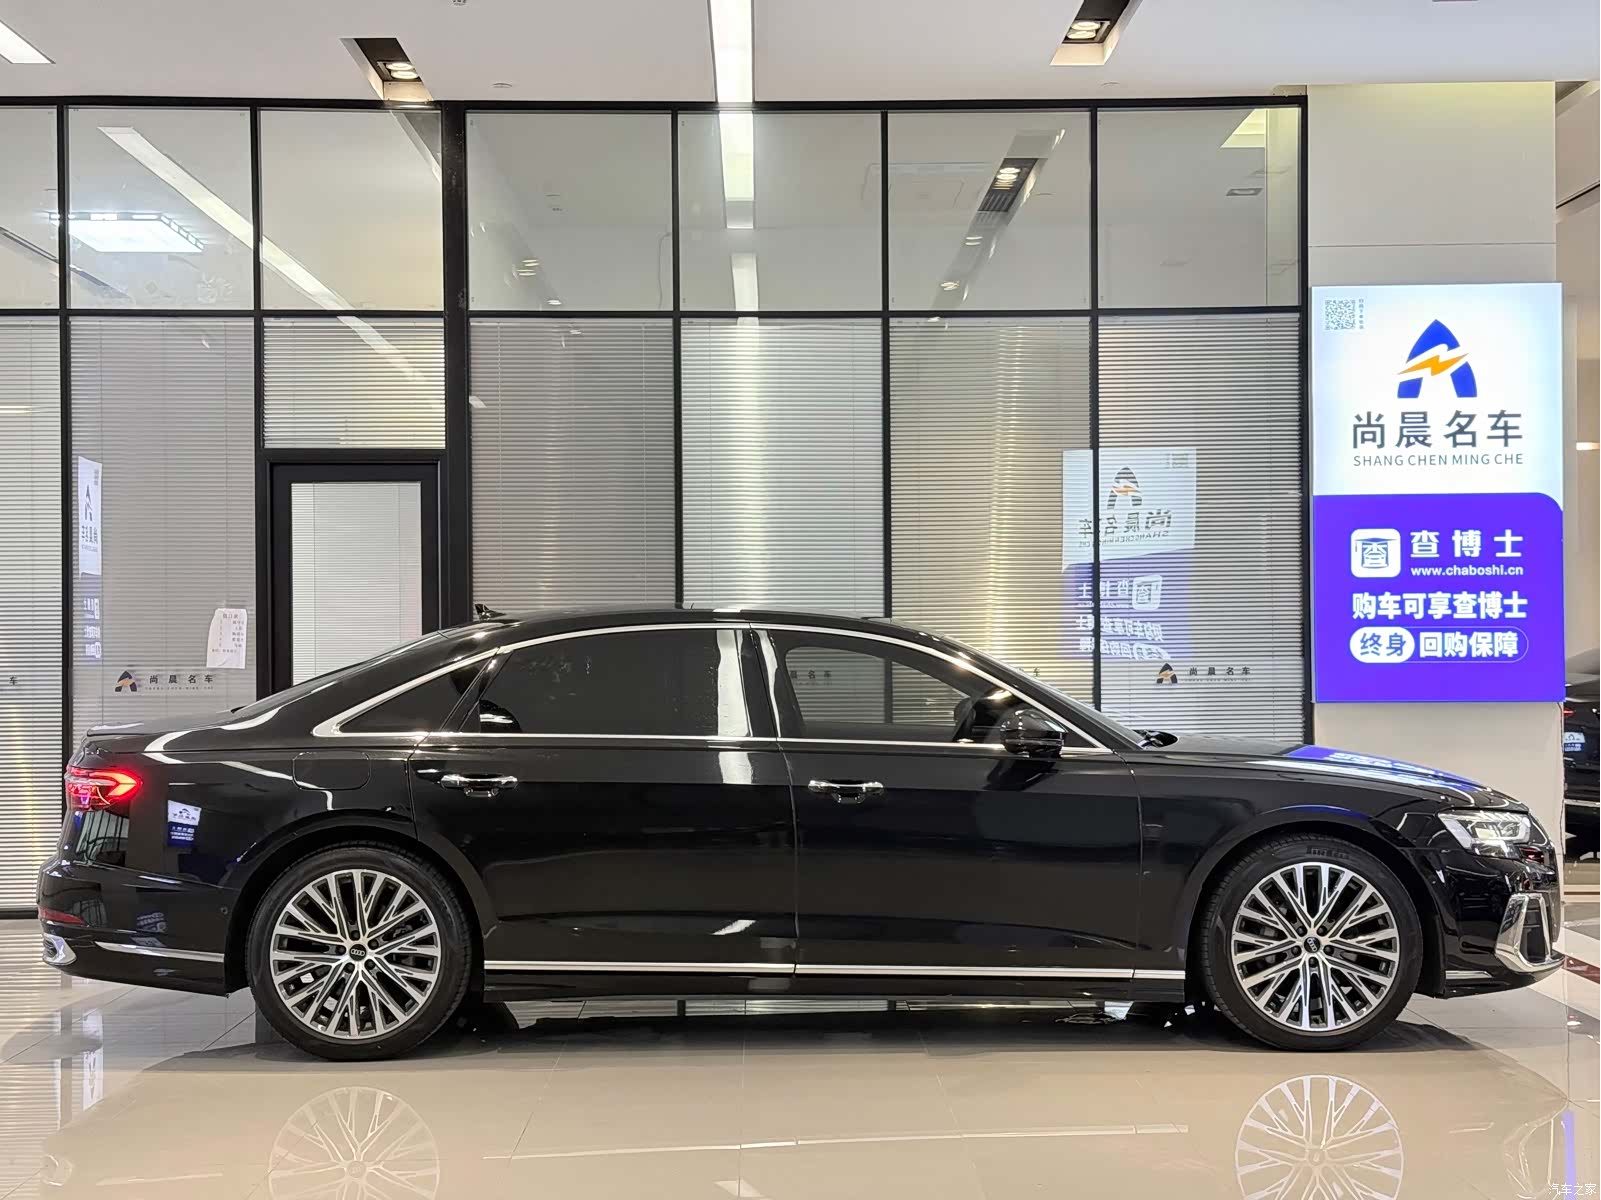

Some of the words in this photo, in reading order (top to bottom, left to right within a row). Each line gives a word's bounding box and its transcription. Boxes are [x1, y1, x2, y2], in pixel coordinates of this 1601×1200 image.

[1353, 410, 1523, 449] 尚晨名车
[1353, 455, 1404, 467] SHANG
[1408, 454, 1447, 466] CHEN
[1452, 454, 1490, 465] MING
[1494, 453, 1523, 465] CHE
[1410, 529, 1523, 558] 查博士
[1410, 564, 1524, 577] www.chaboshi.cn
[1352, 591, 1528, 620] 购车可享查博士
[1360, 632, 1407, 657] 终身
[1419, 631, 1519, 658] 回购保障
[149, 674, 213, 685] 尚晨名车
[1189, 667, 1251, 676] 尚晨名车
